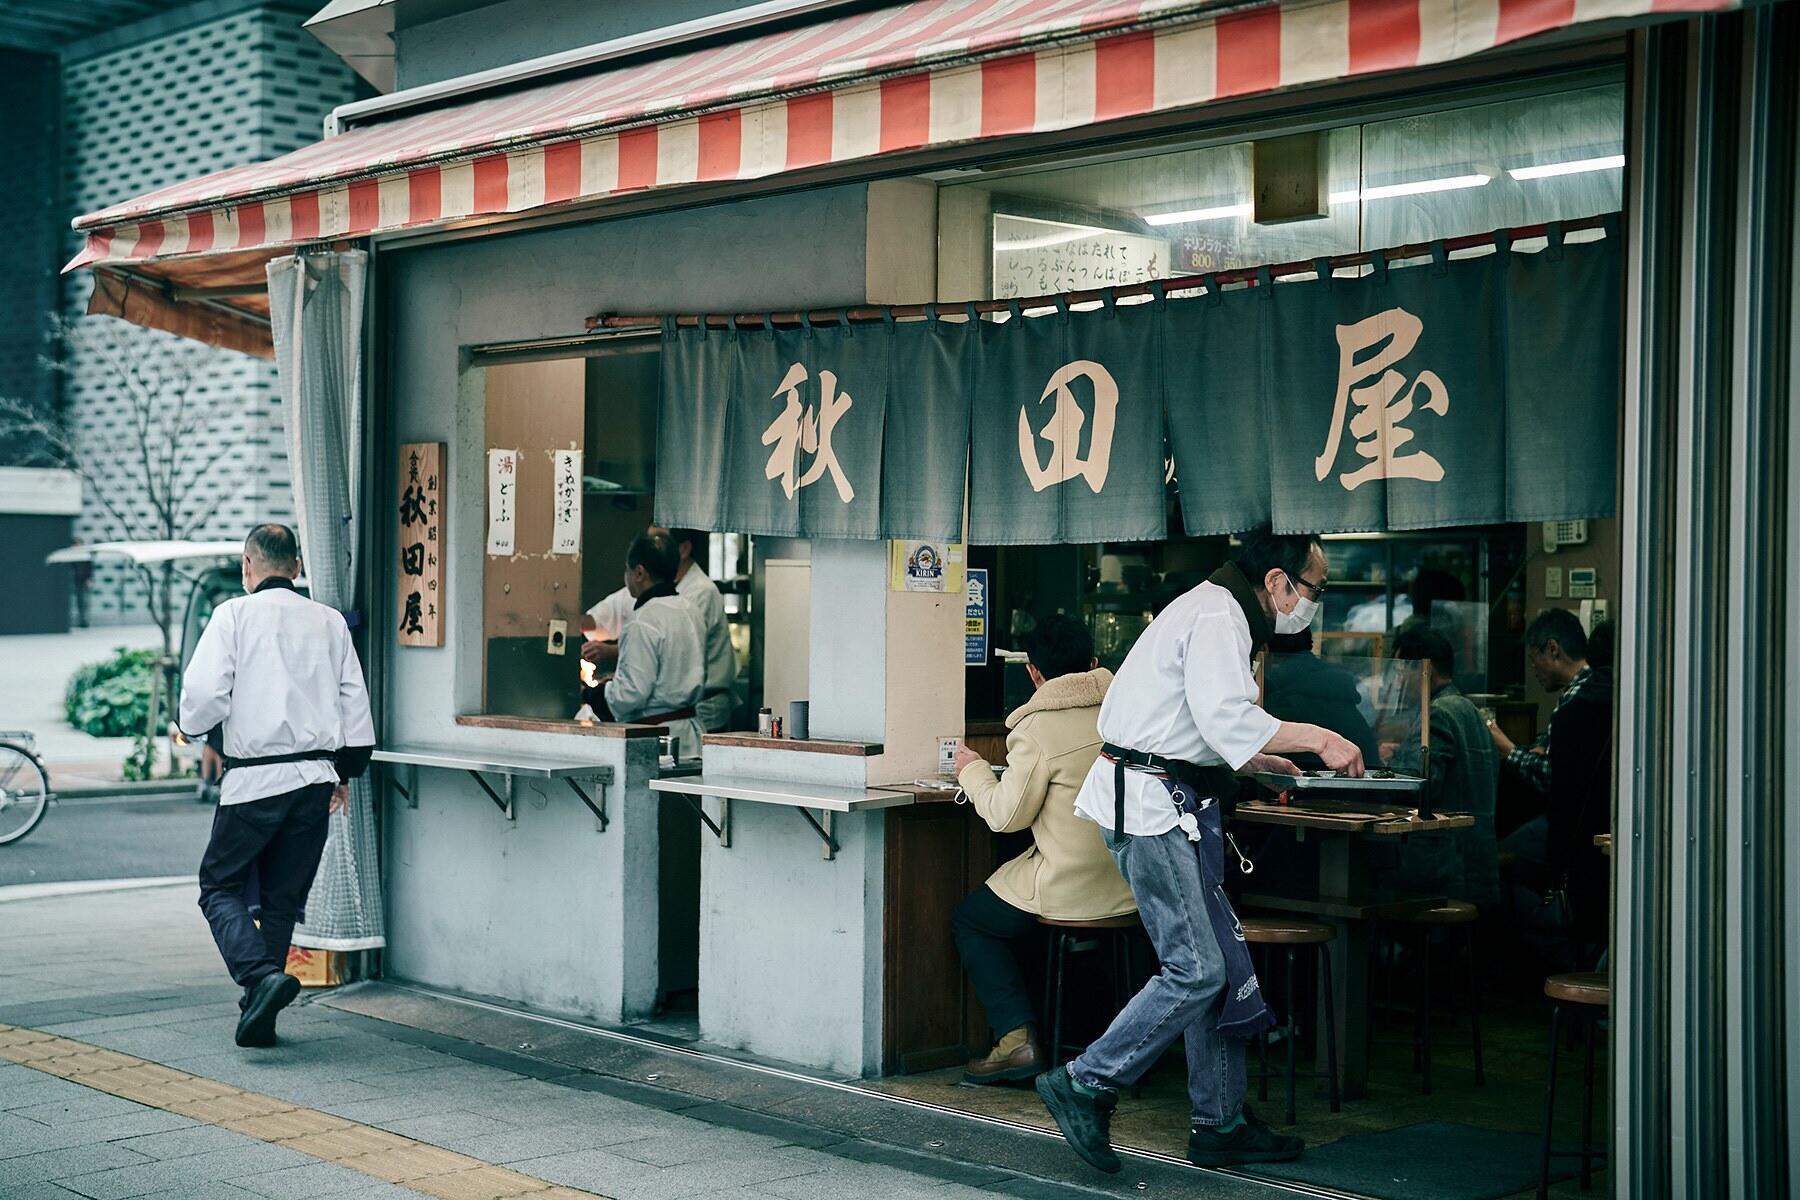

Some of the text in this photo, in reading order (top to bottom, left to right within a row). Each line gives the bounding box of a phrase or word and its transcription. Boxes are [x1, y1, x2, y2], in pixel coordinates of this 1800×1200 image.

[761, 307, 1449, 503] 秋田屋
[400, 485, 427, 636] 秋田屋
[915, 568, 935, 577] KIRIN
[965, 607, 984, 616] ださい
